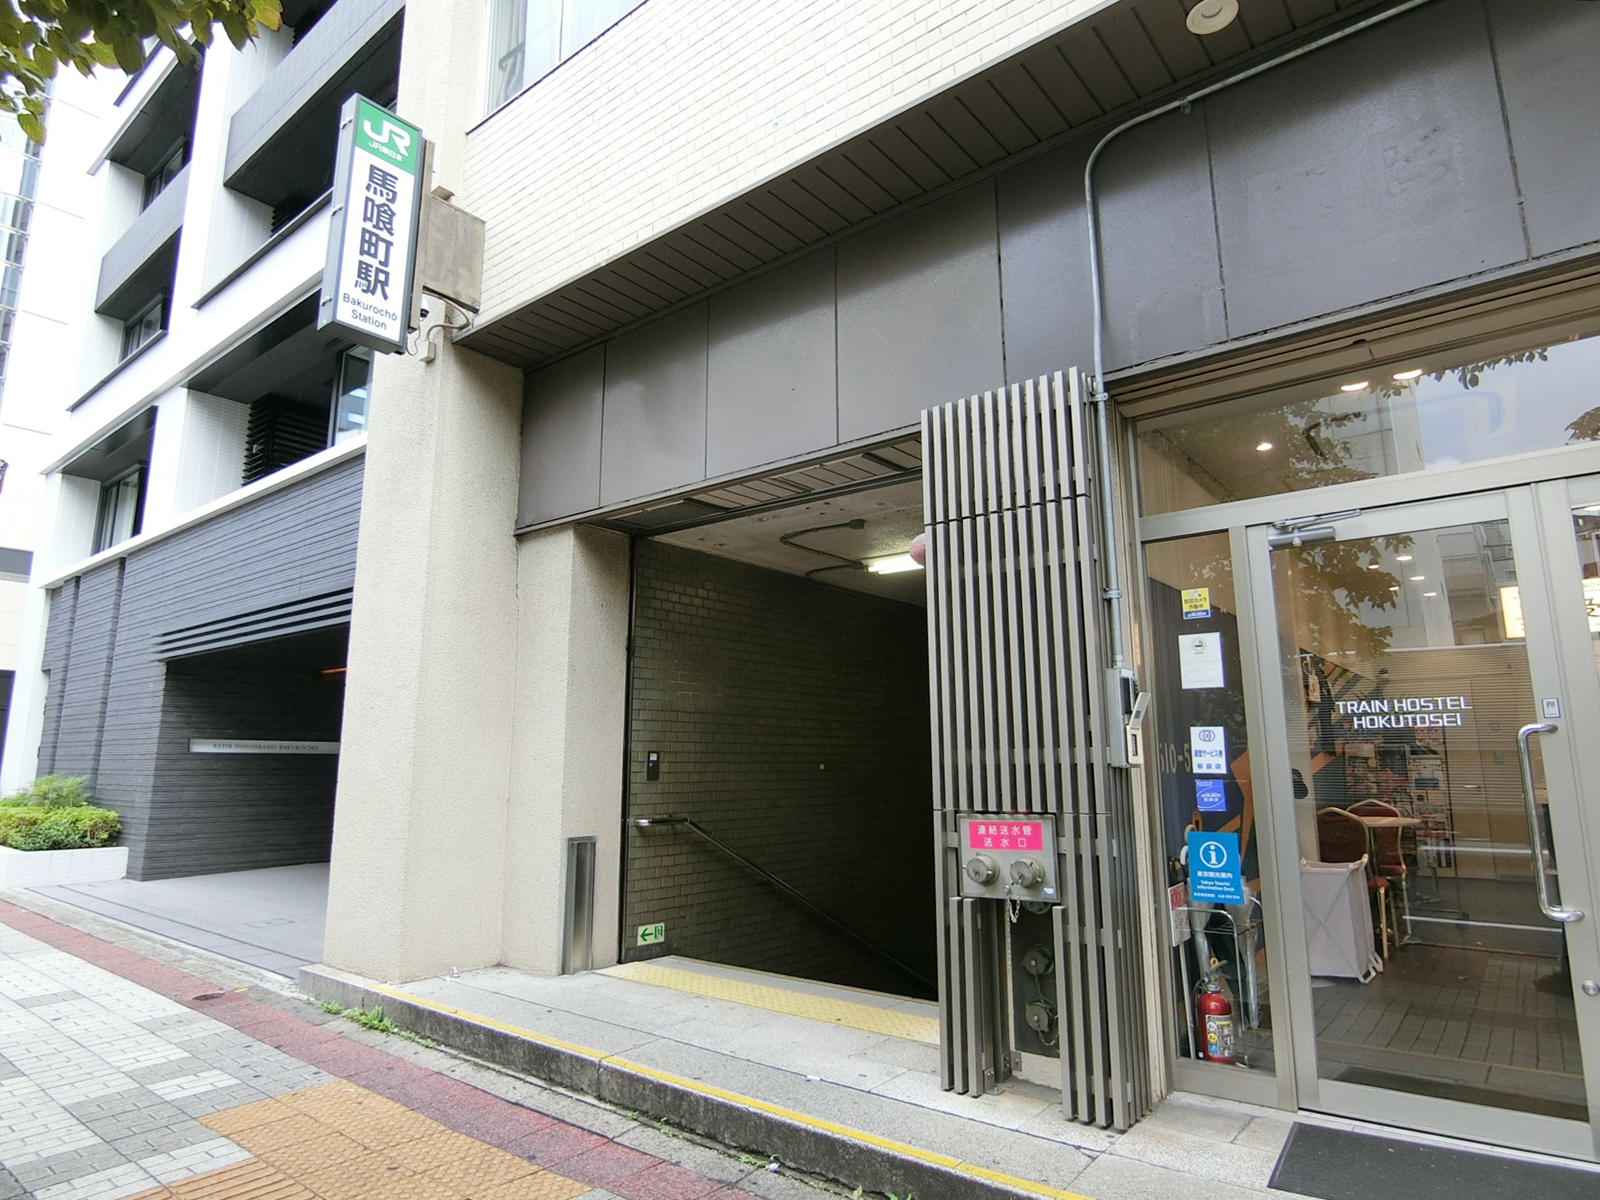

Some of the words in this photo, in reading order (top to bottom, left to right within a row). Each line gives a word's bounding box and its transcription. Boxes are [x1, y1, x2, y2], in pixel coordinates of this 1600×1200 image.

[363, 119, 411, 157] JR
[354, 164, 398, 301] 馬喰町駅
[351, 309, 387, 330] Station
[1335, 699, 1388, 714] TRAIN
[1394, 696, 1473, 711] HOSTEL
[1353, 713, 1462, 729] HOKUTOSEI
[977, 824, 1032, 835] 連結送水管
[983, 837, 1027, 848] 送水口
